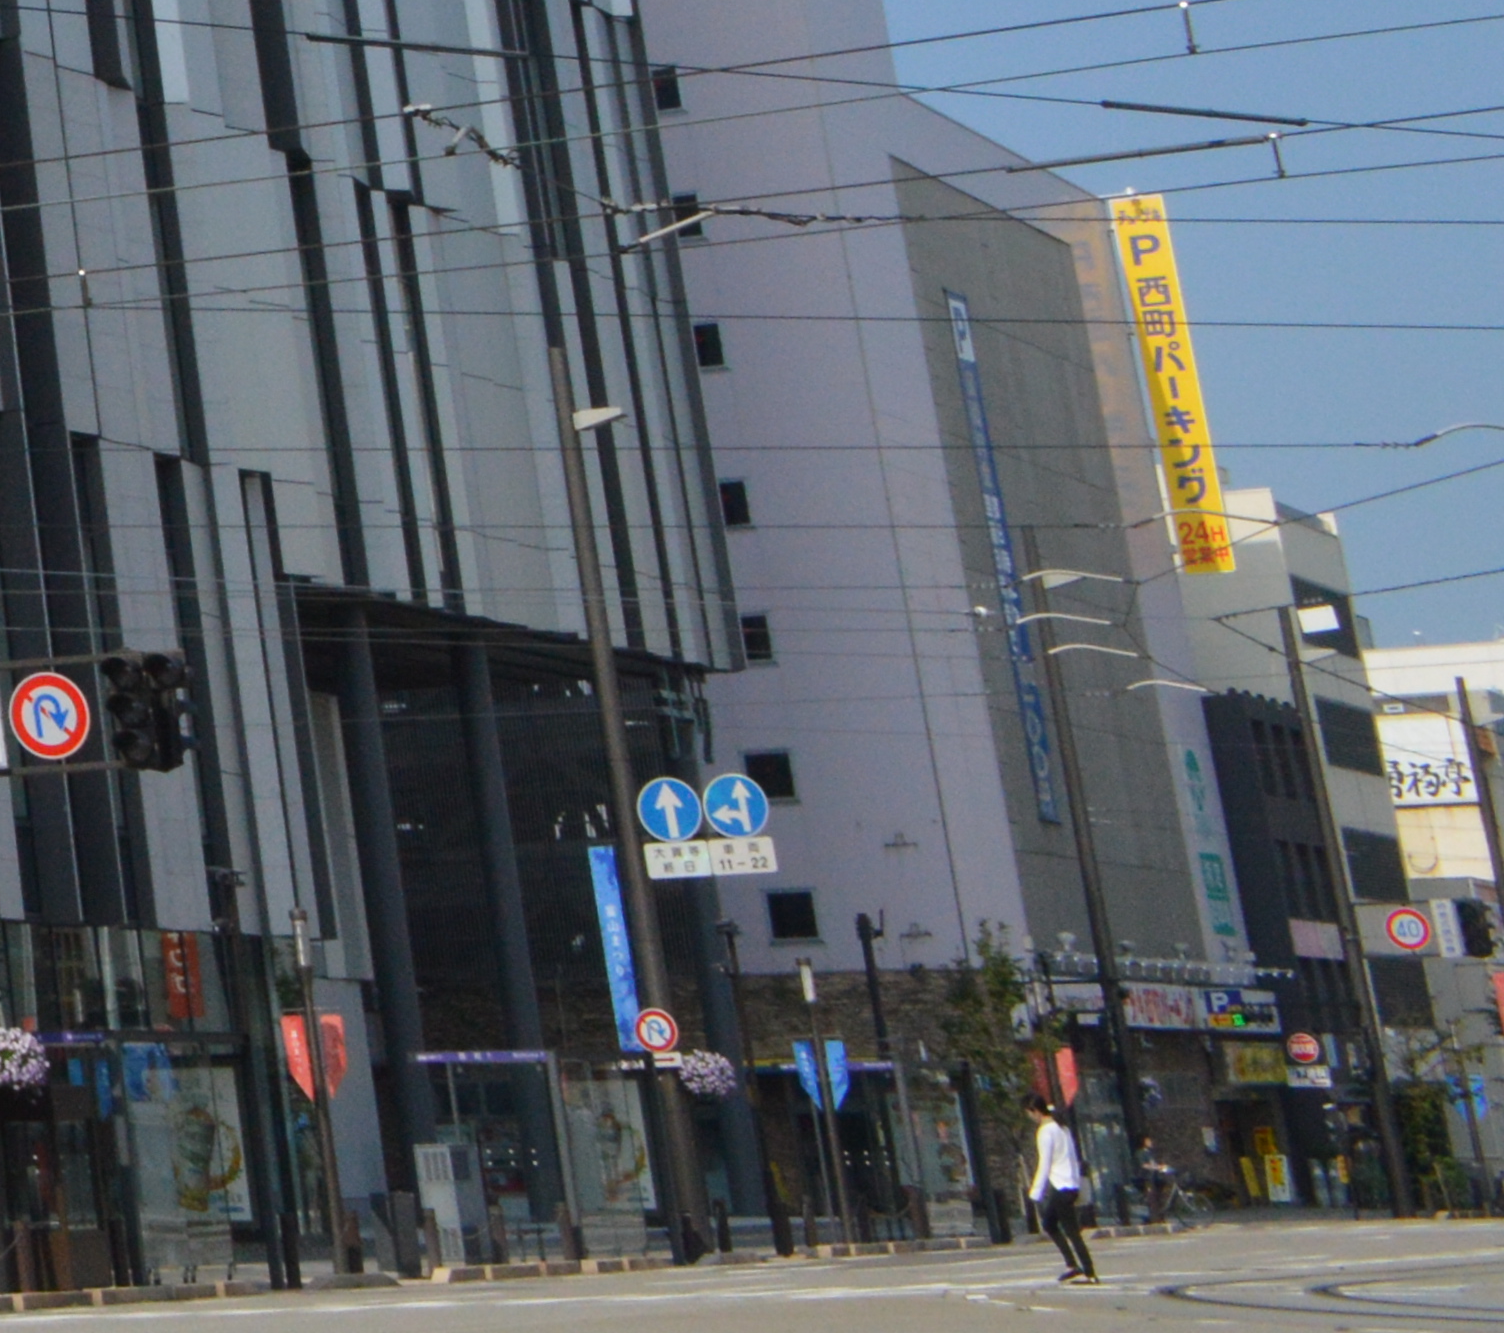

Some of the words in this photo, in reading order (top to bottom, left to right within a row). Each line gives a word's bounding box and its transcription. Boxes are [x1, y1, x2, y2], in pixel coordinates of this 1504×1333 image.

[1129, 233, 1161, 267] P
[1136, 275, 1207, 505] 西町パーキング
[1178, 520, 1227, 547] 24H
[1396, 919, 1421, 939] 40
[1209, 991, 1230, 1013] P
